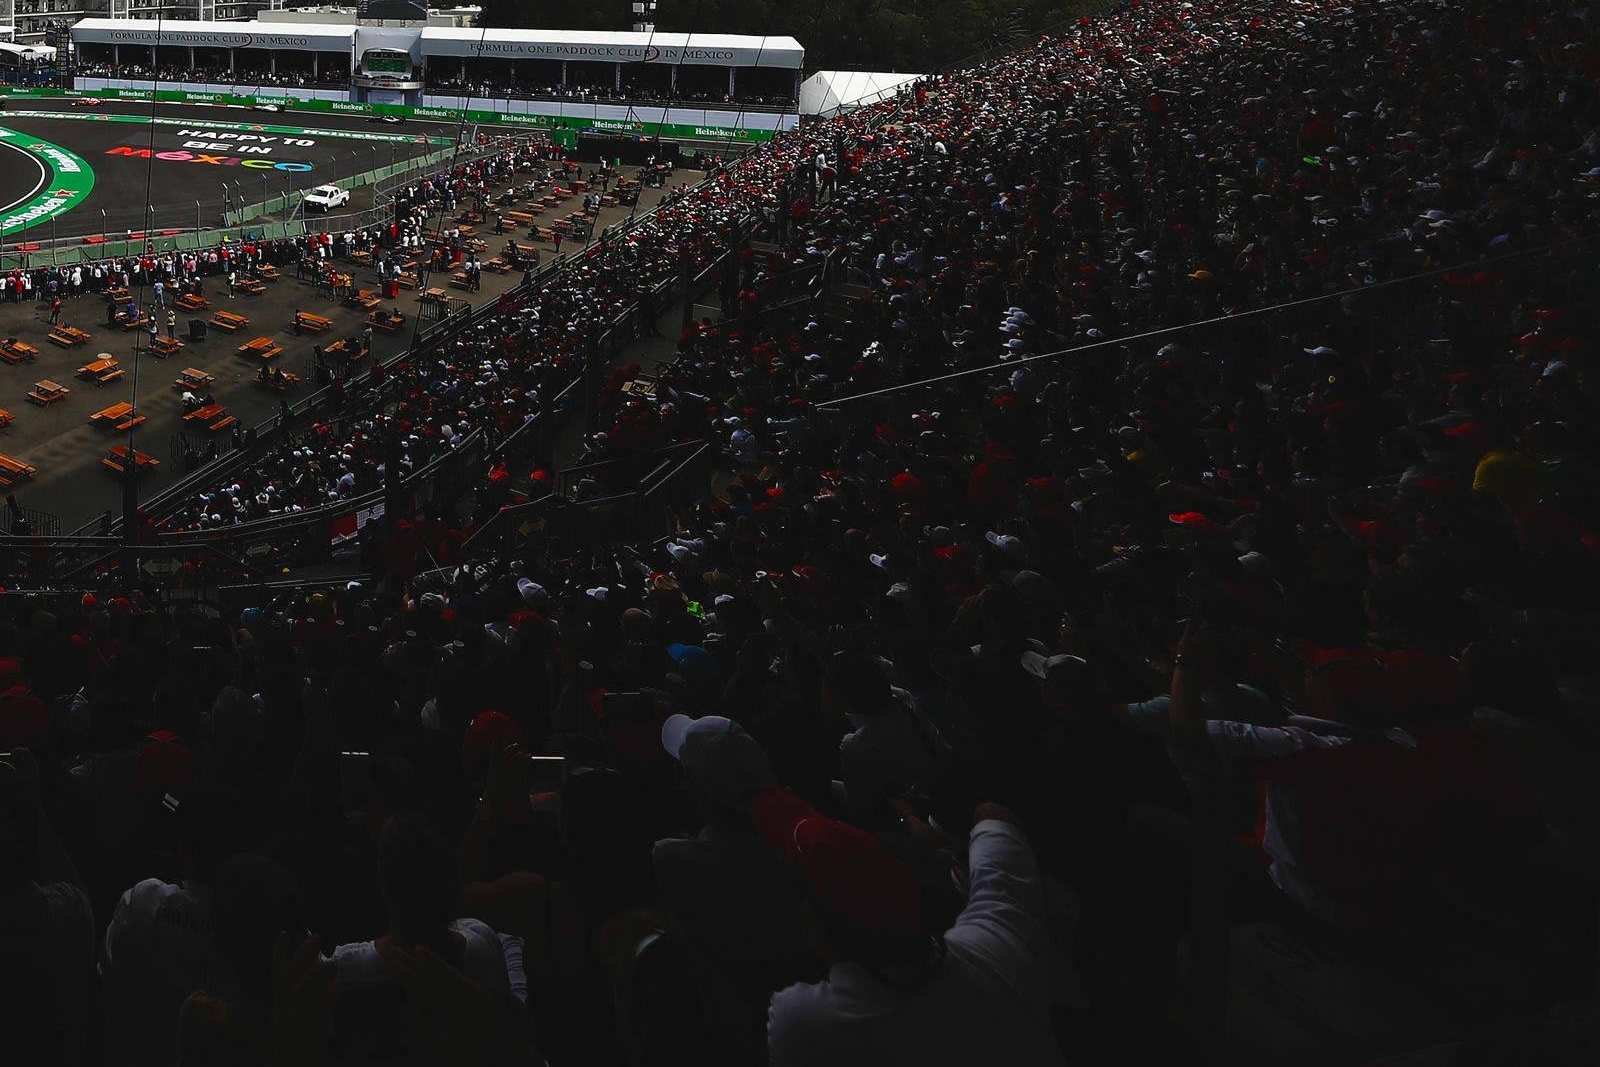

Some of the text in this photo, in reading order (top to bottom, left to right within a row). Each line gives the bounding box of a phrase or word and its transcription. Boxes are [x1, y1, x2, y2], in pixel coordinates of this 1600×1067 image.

[110, 32, 152, 41] FORMULA
[155, 33, 173, 41] ONE
[176, 34, 219, 43] PADDOCK
[222, 35, 247, 44] CLUB
[256, 36, 266, 44] IN
[470, 43, 523, 53] FORMULA
[528, 45, 552, 54] ONE
[556, 46, 614, 56] PADDOCK
[618, 48, 651, 58] CLUB
[665, 50, 678, 58] IN
[256, 97, 285, 105] Heineken
[332, 102, 363, 111] Heineken
[414, 108, 447, 117] Heineken
[501, 114, 537, 123] Heineken
[594, 120, 632, 130] Heineken
[695, 127, 737, 137] Heineken
[176, 128, 315, 147] HAPPY TO
[181, 140, 273, 155] BE IN
